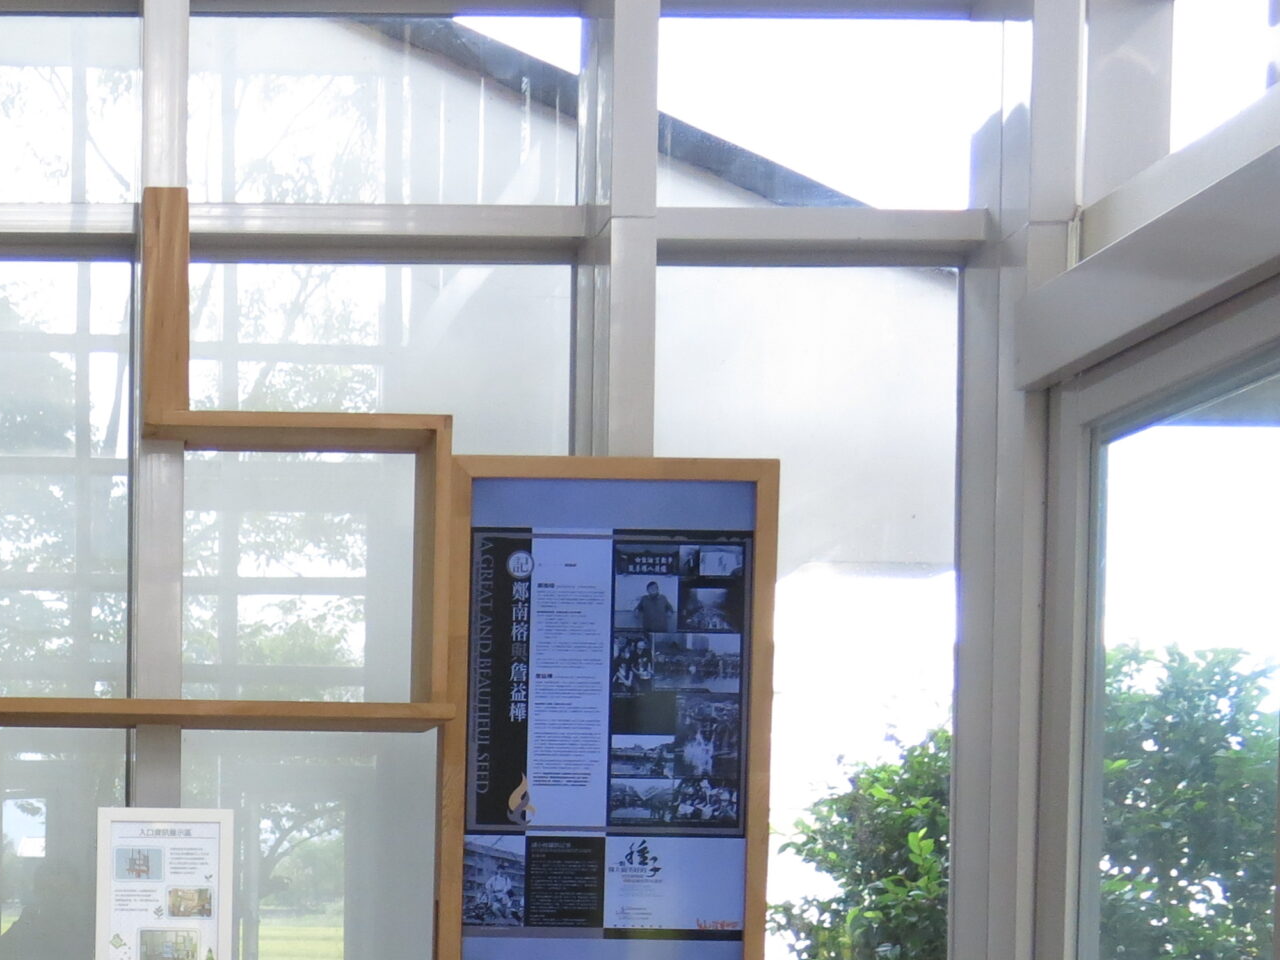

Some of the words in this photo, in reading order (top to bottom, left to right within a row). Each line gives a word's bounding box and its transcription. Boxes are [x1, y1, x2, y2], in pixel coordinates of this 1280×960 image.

[480, 555, 494, 610] GREAT
[479, 615, 493, 653] AND
[475, 753, 489, 793] SEED
